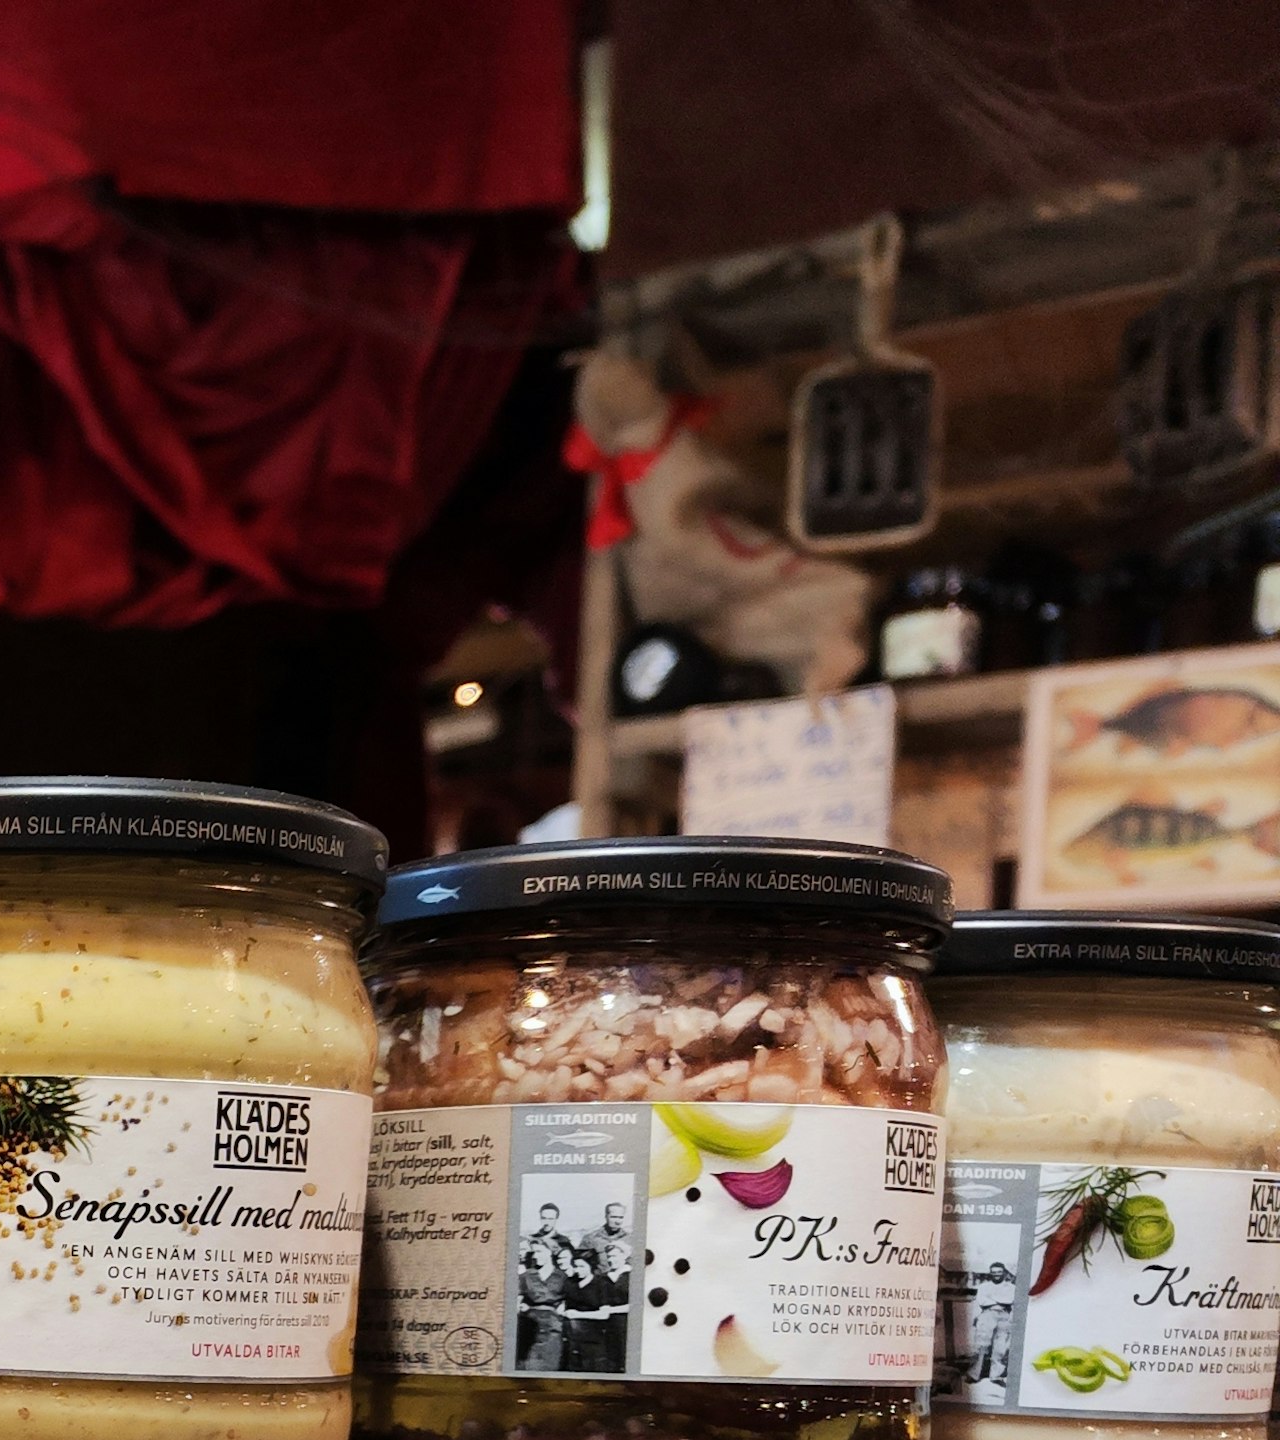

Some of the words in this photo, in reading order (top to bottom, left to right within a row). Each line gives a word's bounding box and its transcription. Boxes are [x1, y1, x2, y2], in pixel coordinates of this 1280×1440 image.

[28, 816, 66, 834] SILL
[72, 812, 122, 835] FRÅN
[128, 814, 266, 845] KLÄDESHOLMEN
[523, 876, 580, 894] EXTRA
[587, 873, 642, 892] PRIMA
[649, 872, 686, 889] SILL
[692, 867, 740, 888] FRÅN
[745, 872, 872, 895] KLÄDESHOLMEN
[1014, 943, 1072, 959] EXTRA
[1077, 945, 1131, 959] PRIMA
[1136, 945, 1168, 961] SILL
[216, 1098, 310, 1135] KLÄDES
[525, 1114, 636, 1126] SILLTRADITION
[374, 1121, 426, 1136] LÖKSILL
[214, 1133, 308, 1166] HOLMEN
[887, 1125, 937, 1161] KLÄDES
[534, 1154, 585, 1165] REDAN
[590, 1154, 624, 1164] 1594
[885, 1158, 935, 1188] HOLMEN
[17, 1171, 233, 1239] Senapssill
[232, 1191, 302, 1229] med
[452, 1212, 492, 1223] varav
[748, 1215, 858, 1263] PK:s
[104, 1244, 195, 1261] ANGENÄM
[205, 1249, 236, 1263] SILL
[243, 1250, 272, 1264] MED
[108, 1266, 146, 1279] OCH
[156, 1268, 219, 1282] HAVETS
[227, 1268, 268, 1284] SÄLTA
[121, 1287, 194, 1301] TYDLIGT
[202, 1290, 268, 1303] KOMMER
[422, 1288, 489, 1301] Snörpvad
[769, 1284, 870, 1299] TRADITIONELL
[773, 1303, 841, 1316] MOGNAD
[773, 1319, 801, 1333] LÖK
[809, 1323, 839, 1334] OCH
[845, 1322, 885, 1336] VITLÖK
[1164, 1328, 1219, 1340] UTVALDA
[192, 1343, 261, 1358] UTVALDA
[267, 1345, 300, 1358] BITAR
[1123, 1343, 1226, 1357] FÖRBEHANDLAS
[1130, 1361, 1193, 1372] KRYDDAD
